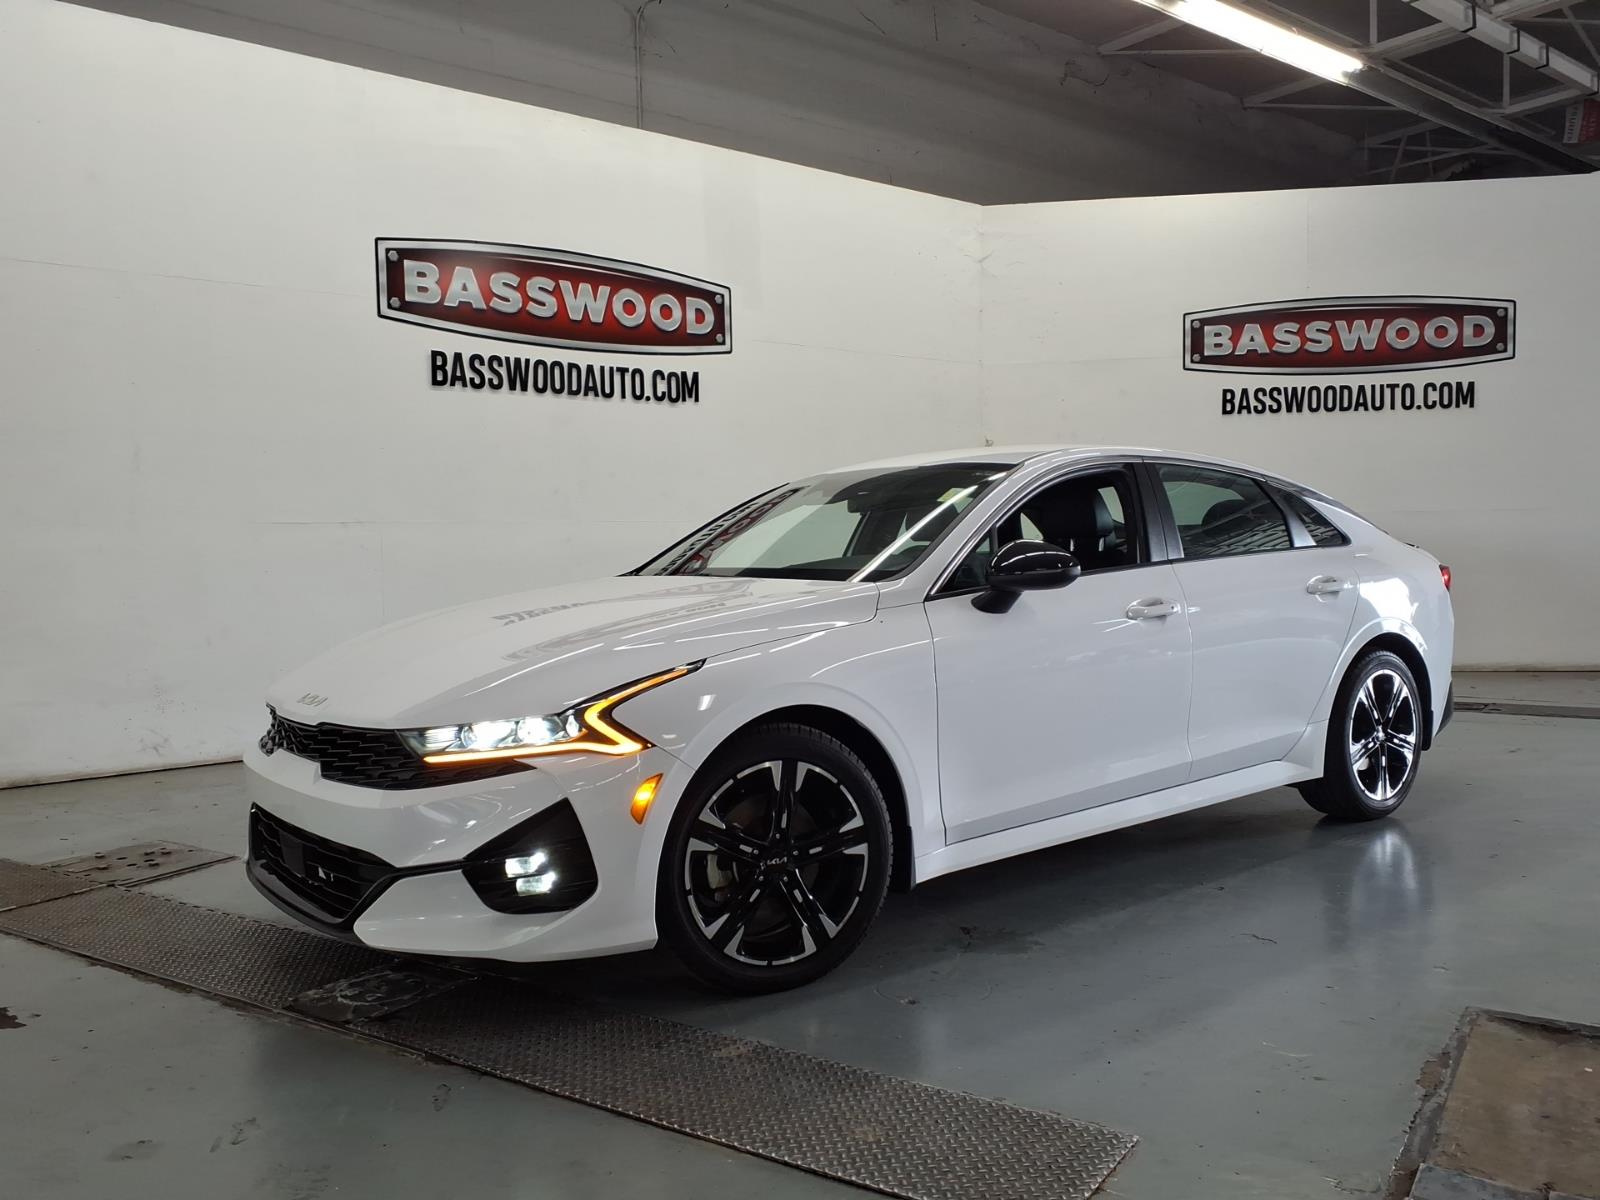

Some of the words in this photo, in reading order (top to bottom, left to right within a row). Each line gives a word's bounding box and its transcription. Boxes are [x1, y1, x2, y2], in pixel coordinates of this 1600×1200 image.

[403, 259, 715, 335] BASSWOOD
[1203, 315, 1496, 356] BASSWOOD
[430, 349, 700, 404] BASSWOODAUTO.COM
[1221, 381, 1476, 415] BASSWOODAUTO.COM
